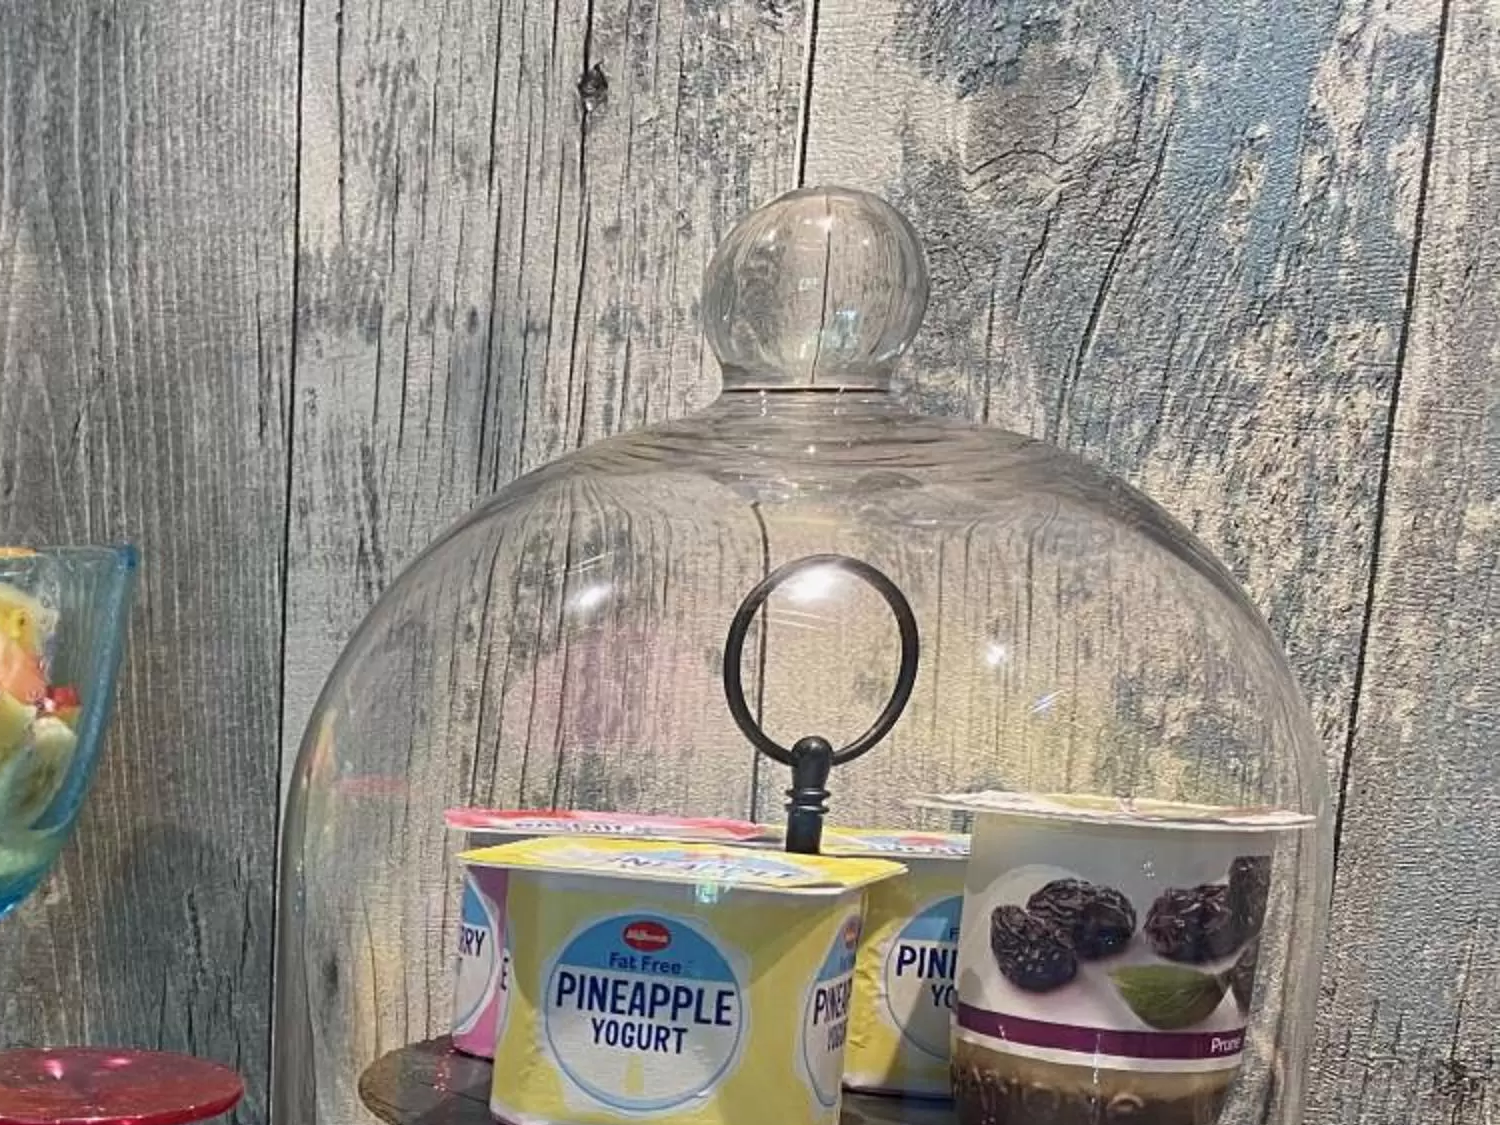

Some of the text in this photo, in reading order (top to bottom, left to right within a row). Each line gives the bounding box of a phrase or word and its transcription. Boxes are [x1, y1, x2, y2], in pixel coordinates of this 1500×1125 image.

[609, 952, 683, 976] Fat Free
[556, 971, 735, 1027] PINEAPPLE
[592, 1017, 689, 1054] YOGURT
